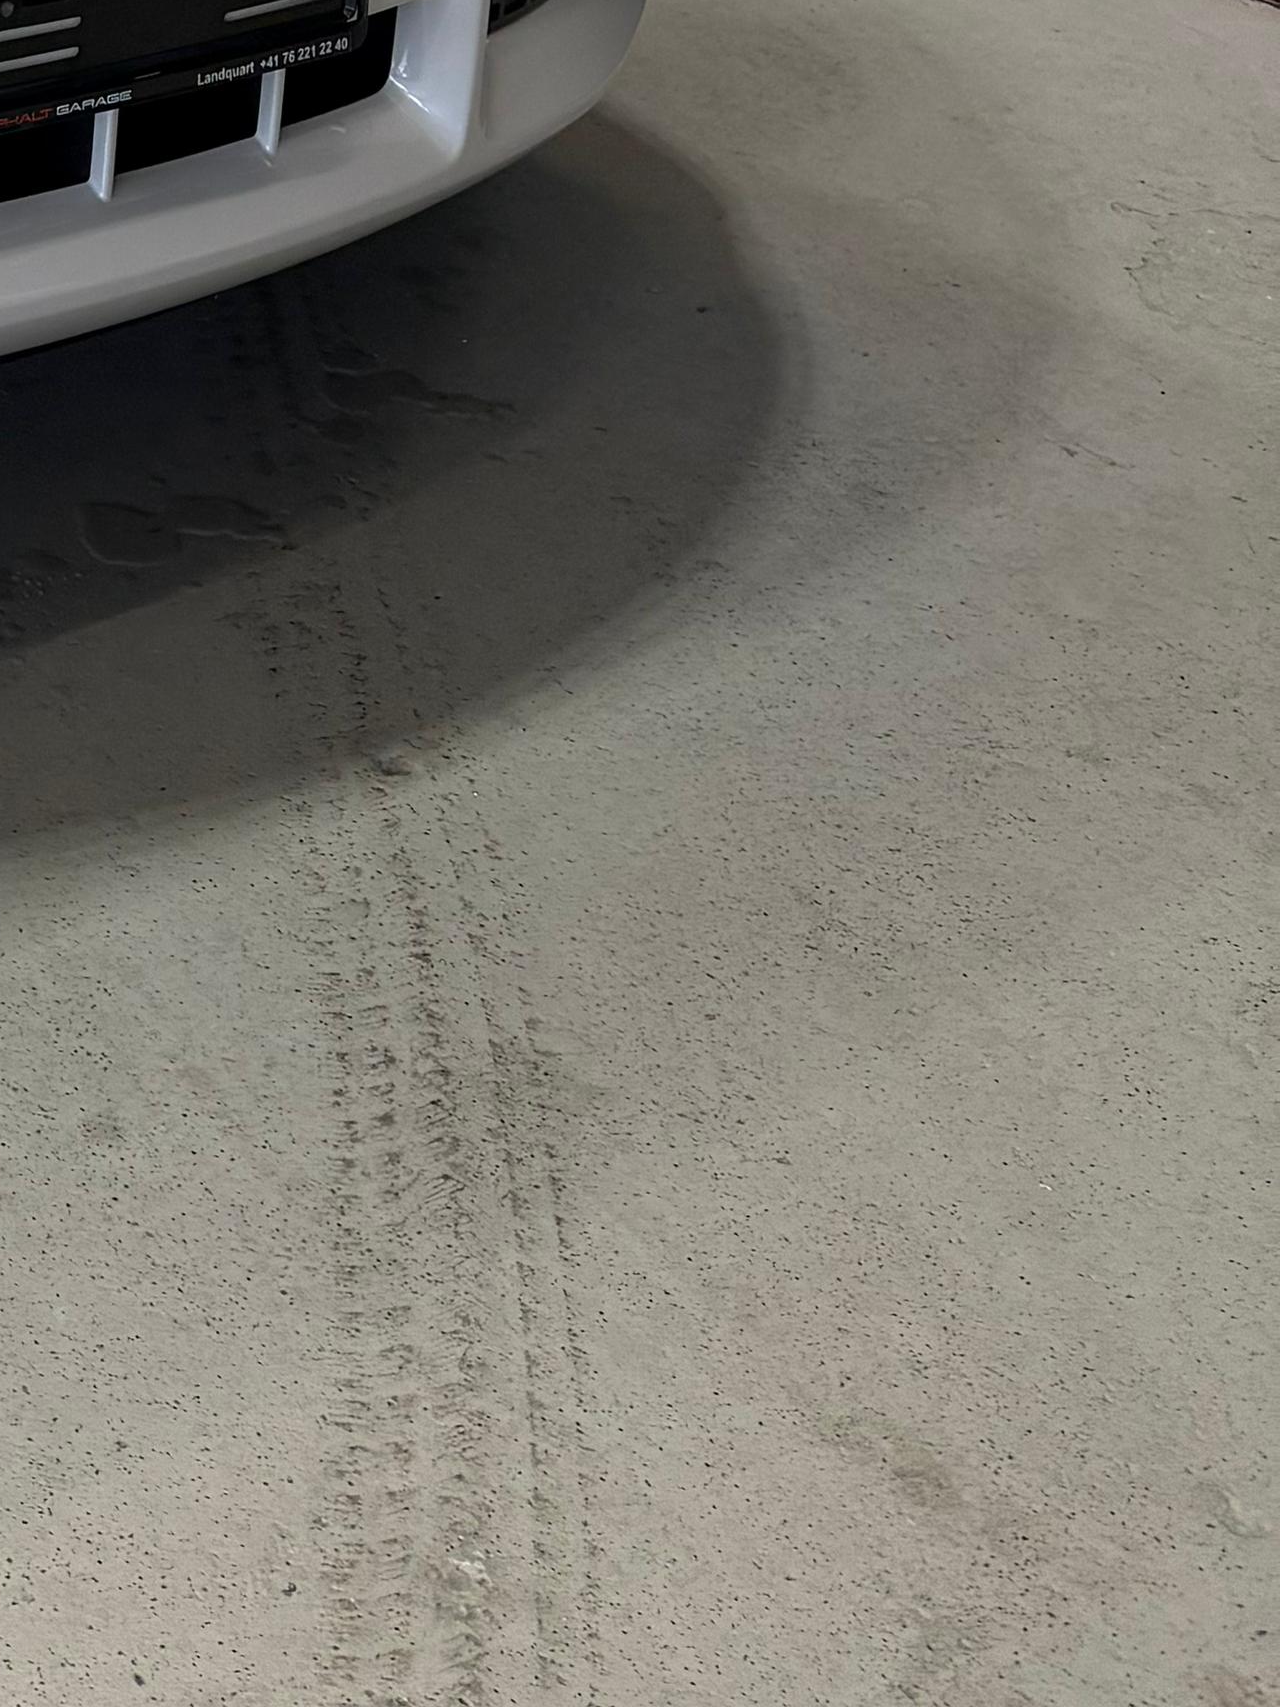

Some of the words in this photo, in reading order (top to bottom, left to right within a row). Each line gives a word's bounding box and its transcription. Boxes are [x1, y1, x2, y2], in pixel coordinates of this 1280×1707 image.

[197, 60, 255, 86] Landquart
[259, 53, 279, 69] +41
[282, 50, 295, 65] 76
[297, 44, 316, 61] 221
[319, 40, 333, 56] 22
[334, 36, 349, 51] 40
[56, 89, 133, 116] GARAGE
